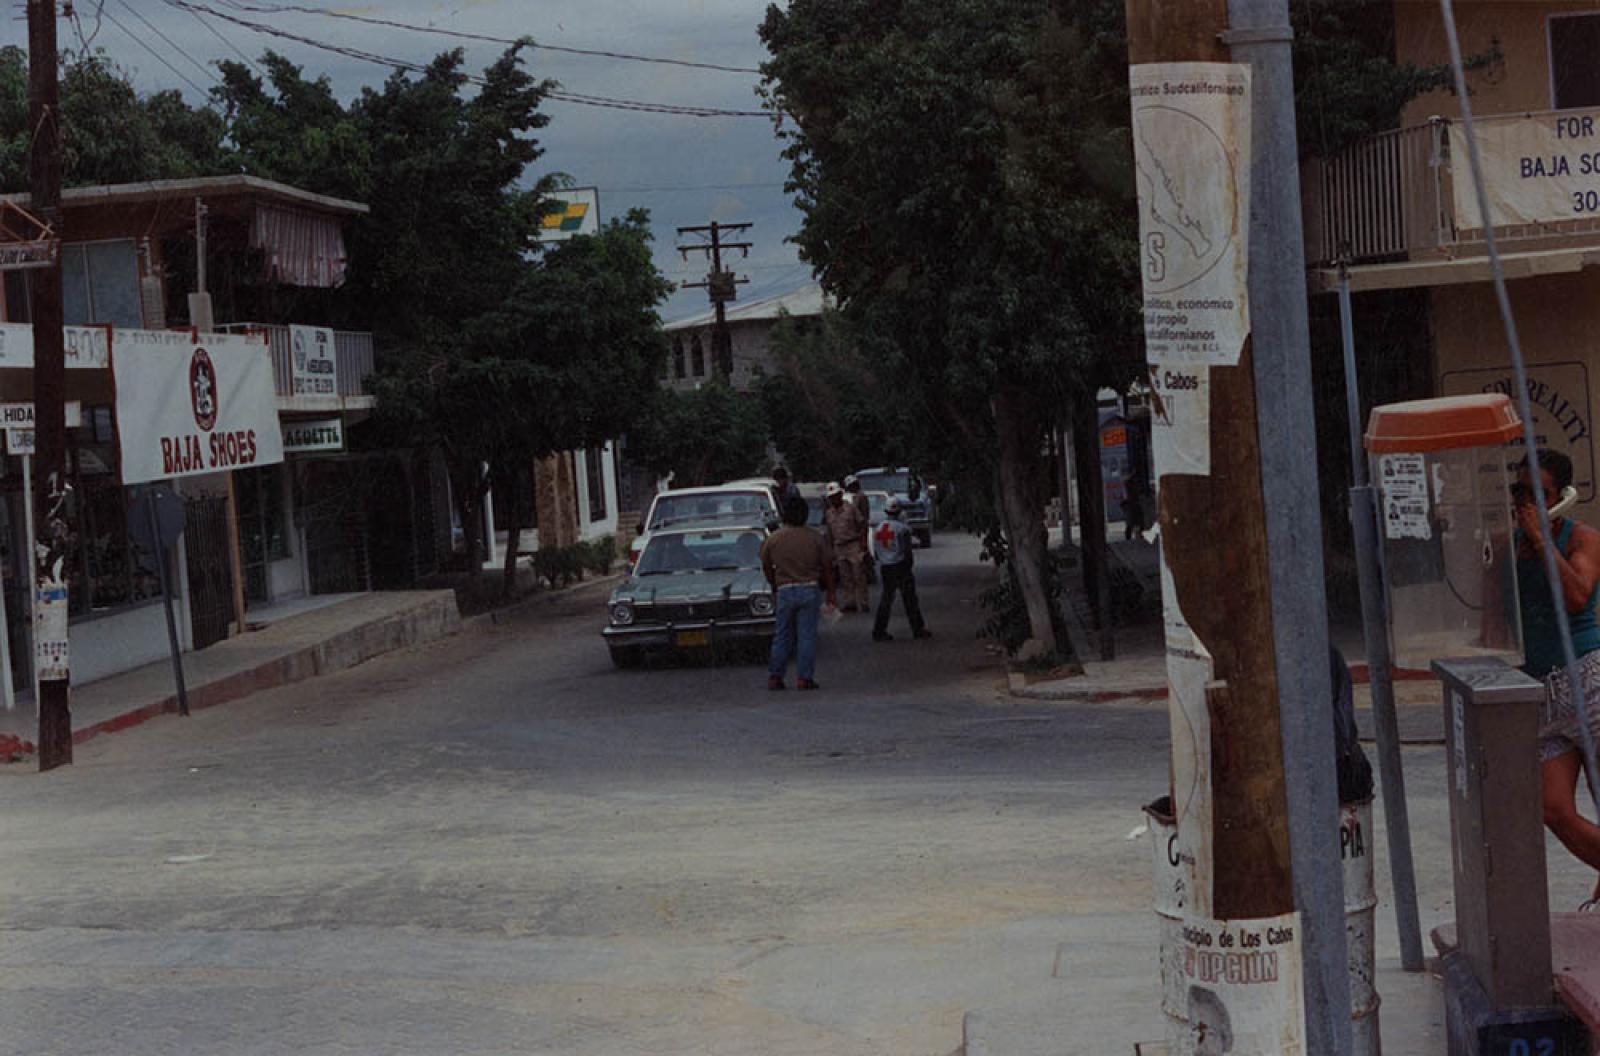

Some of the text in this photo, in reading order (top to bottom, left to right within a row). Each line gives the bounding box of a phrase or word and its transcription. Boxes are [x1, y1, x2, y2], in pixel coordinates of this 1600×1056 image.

[1557, 116, 1594, 139] FOR
[1520, 151, 1600, 178] BAJA SO
[1165, 371, 1198, 390] Cabos
[4, 407, 33, 423] HIDA
[160, 429, 257, 473] BAJA SHOES
[1340, 823, 1365, 860] PIA
[1219, 930, 1233, 947] de
[1240, 928, 1261, 948] Los
[1266, 926, 1293, 945] Cabos
